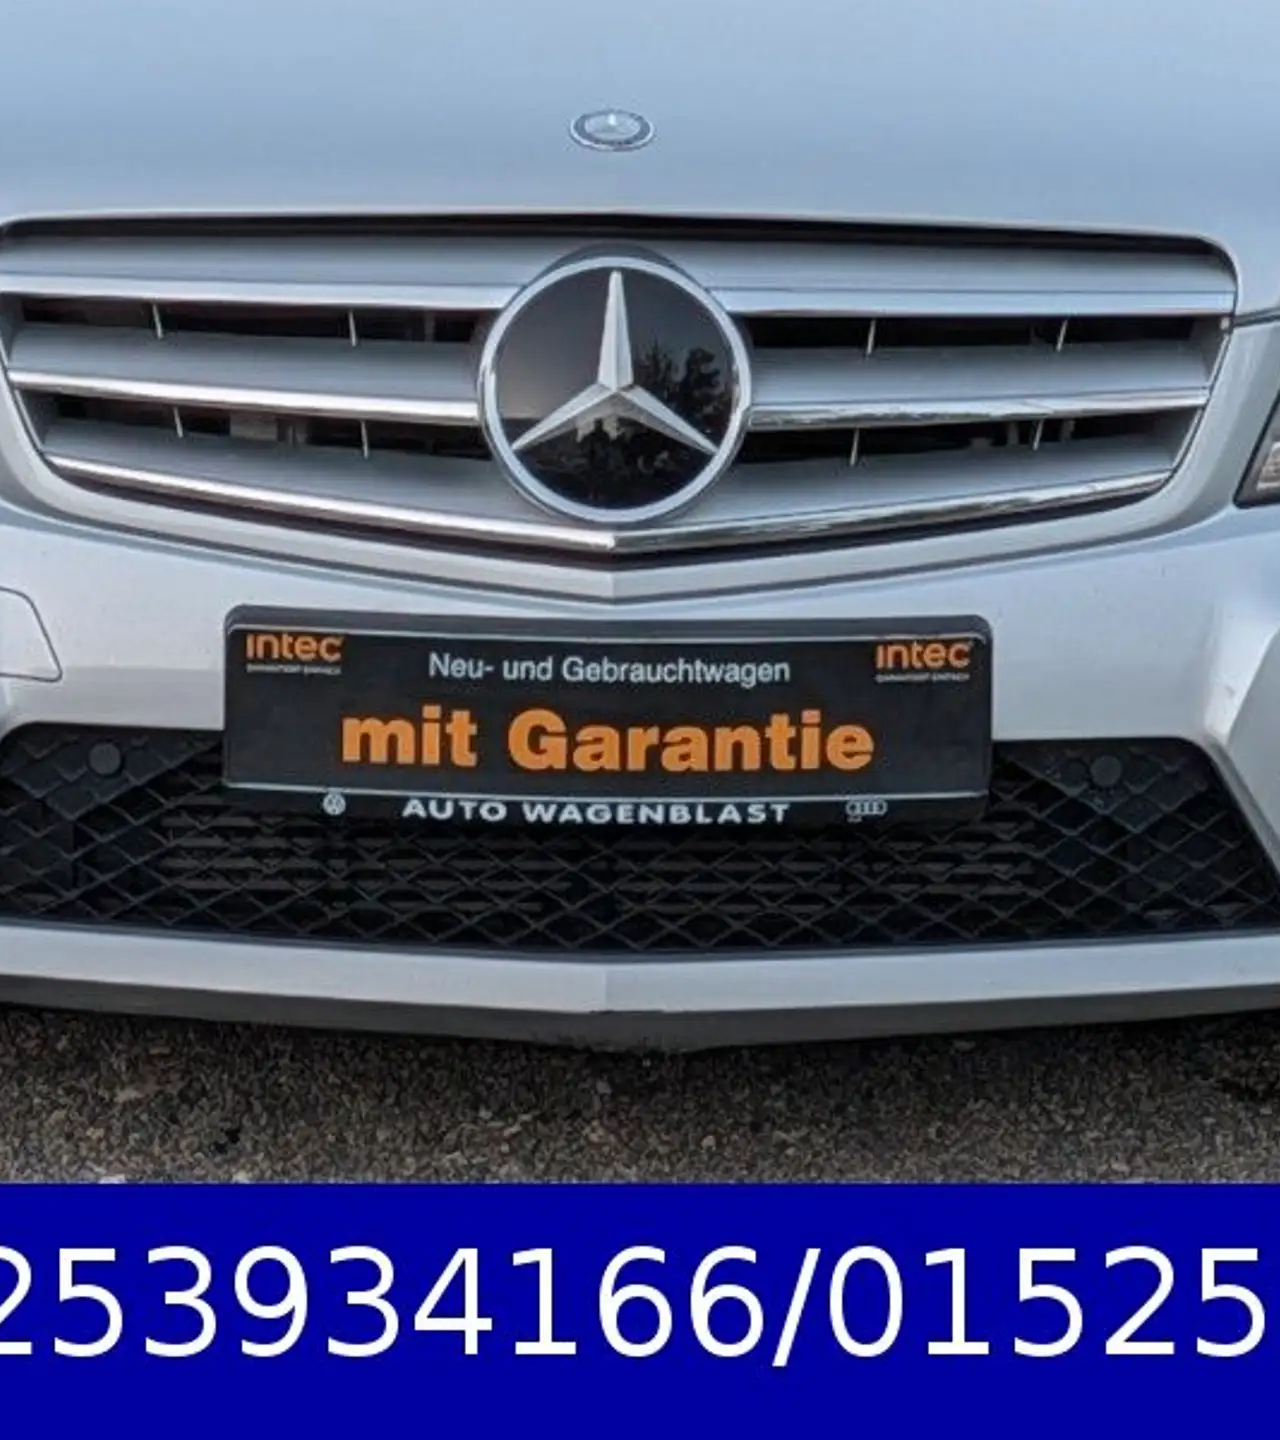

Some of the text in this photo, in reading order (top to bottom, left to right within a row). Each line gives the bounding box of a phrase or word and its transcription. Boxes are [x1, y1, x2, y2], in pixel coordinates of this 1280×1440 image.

[246, 632, 342, 662] intec
[876, 641, 970, 669] intec
[428, 653, 791, 689] Neu- und Gebrauchtwagen
[341, 705, 875, 773] mit Garantie
[402, 798, 790, 825] AUTO WAGENBLAST
